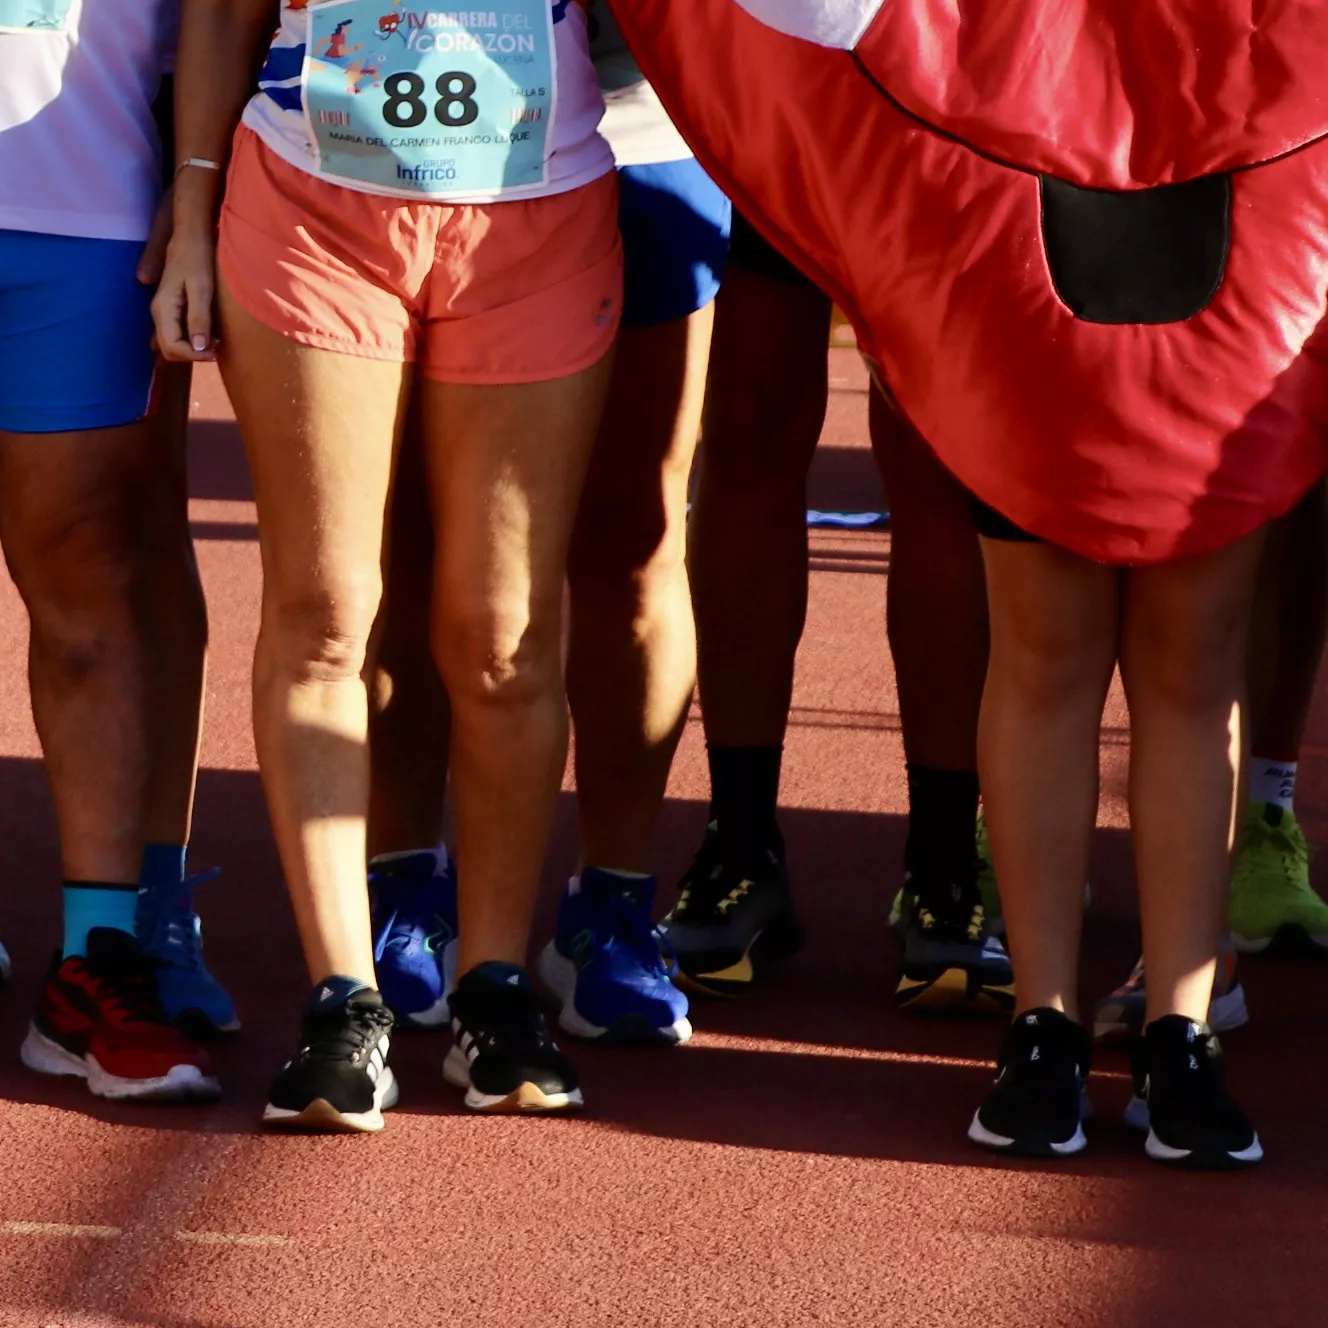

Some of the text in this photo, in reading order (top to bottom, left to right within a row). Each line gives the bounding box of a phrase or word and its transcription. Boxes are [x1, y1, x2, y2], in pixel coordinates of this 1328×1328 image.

[408, 11, 532, 30] IV CARRERA DEL
[382, 71, 479, 129] 88
[329, 131, 363, 144] MARIA
[365, 136, 387, 148] DEL
[390, 136, 440, 148] CARMEN
[443, 135, 492, 147] FRANCO
[397, 163, 456, 180] Infrico
[423, 159, 456, 168] GRUPO
